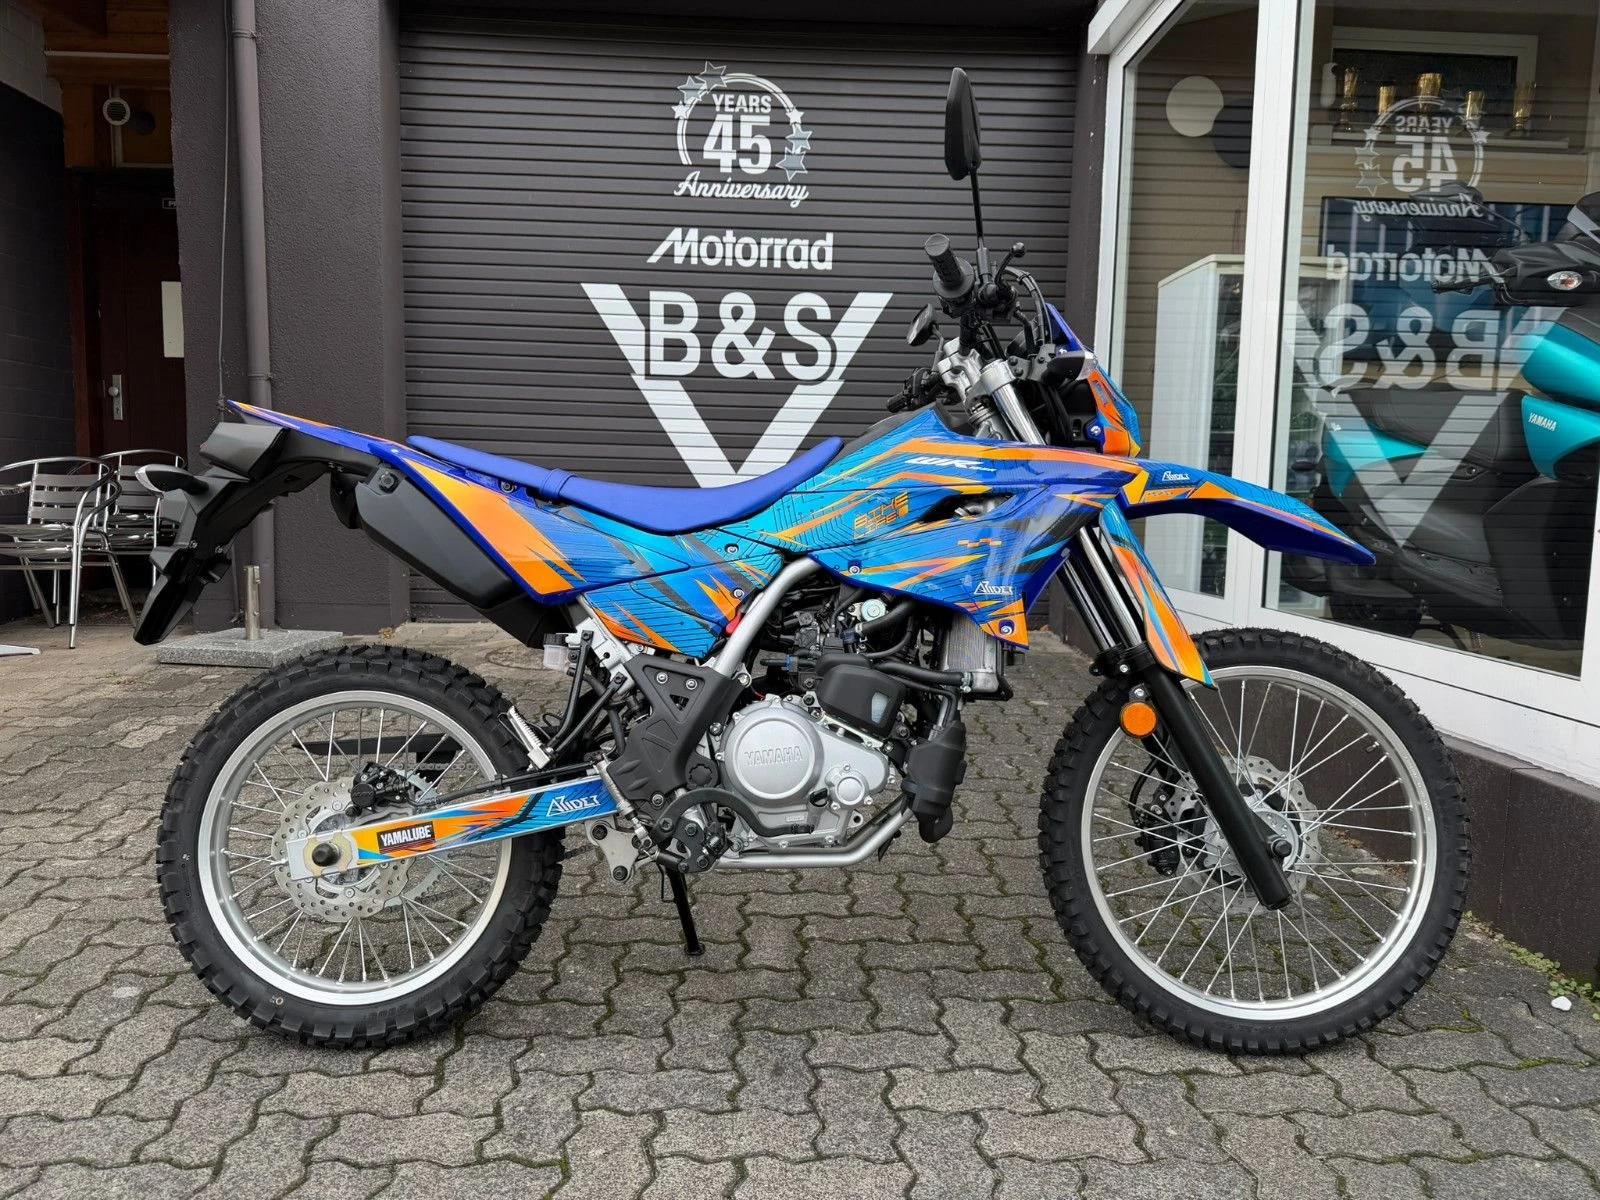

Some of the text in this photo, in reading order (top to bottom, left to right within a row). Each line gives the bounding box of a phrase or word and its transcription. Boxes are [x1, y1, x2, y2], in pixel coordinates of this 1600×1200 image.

[712, 94, 772, 114] YEARS
[703, 114, 772, 175] 45
[673, 170, 809, 208] Anniversary
[646, 227, 834, 270] Motorrad
[649, 290, 833, 381] B&S
[1528, 412, 1557, 432] YAMAHA
[743, 745, 803, 767] YAMAHA
[380, 823, 432, 848] YAMALUBE
